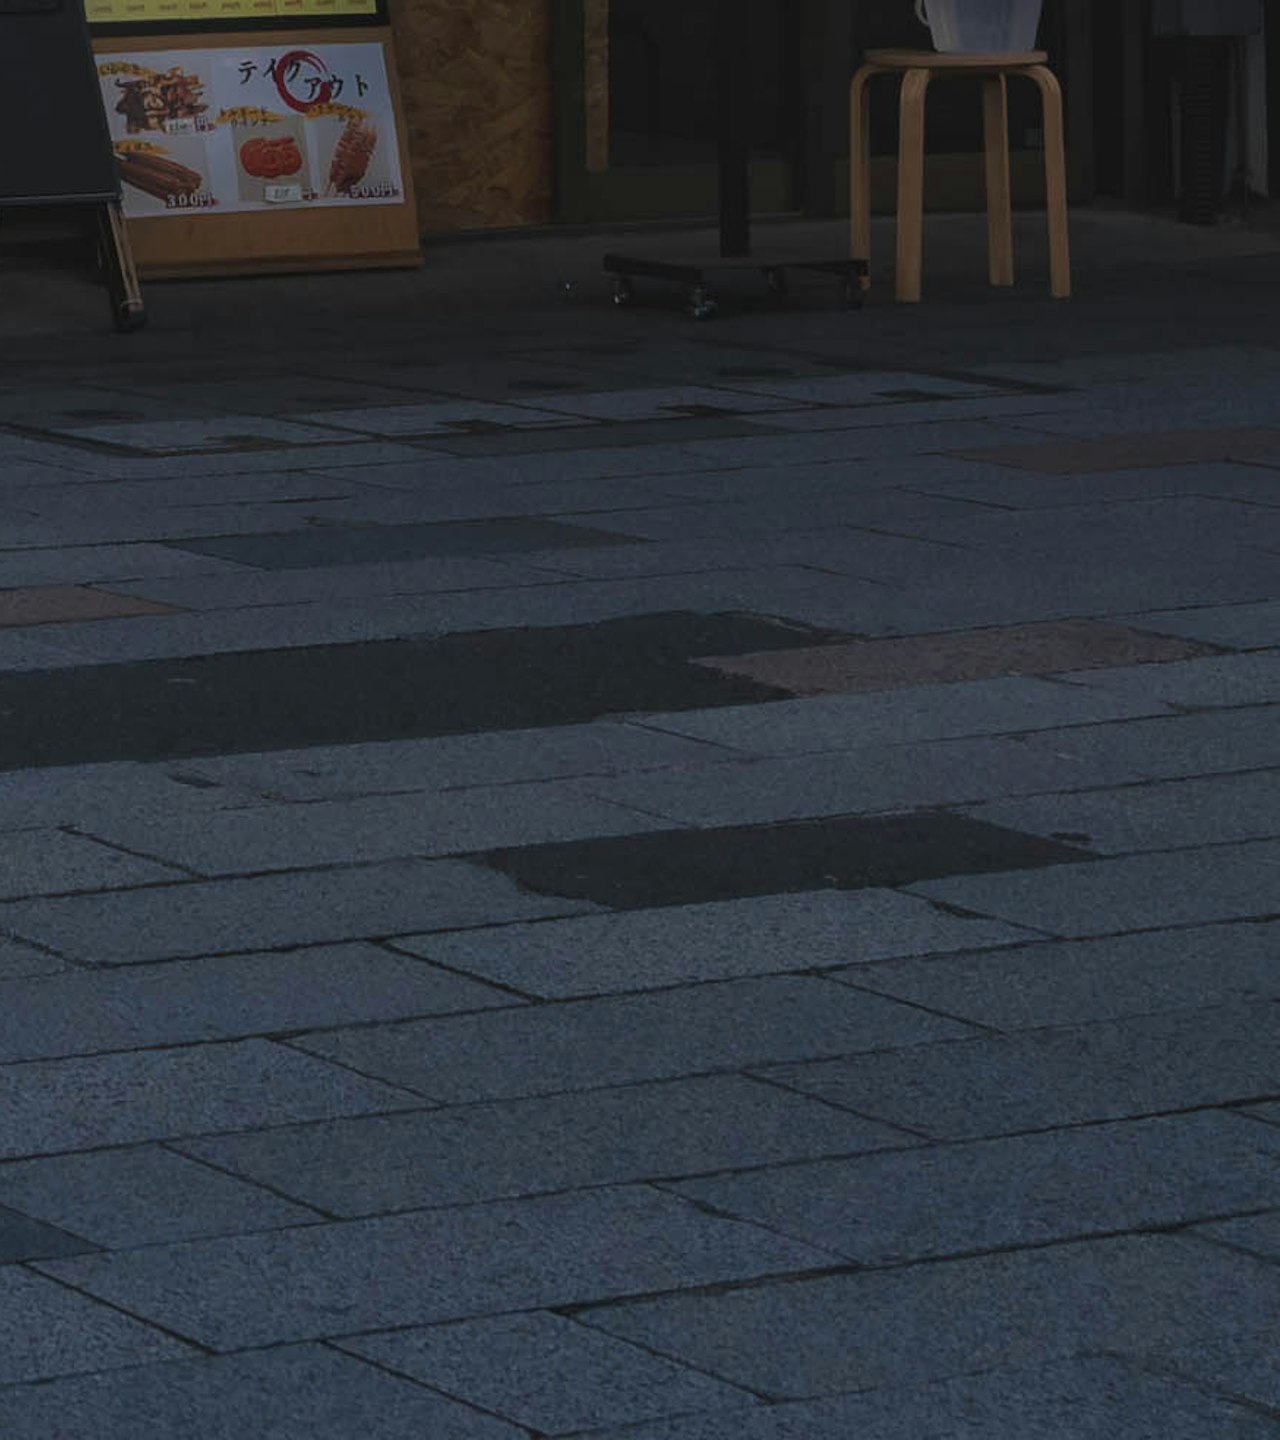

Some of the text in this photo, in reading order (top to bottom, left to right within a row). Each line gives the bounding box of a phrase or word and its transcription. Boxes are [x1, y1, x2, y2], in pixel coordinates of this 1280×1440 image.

[238, 57, 370, 100] テイクアウト
